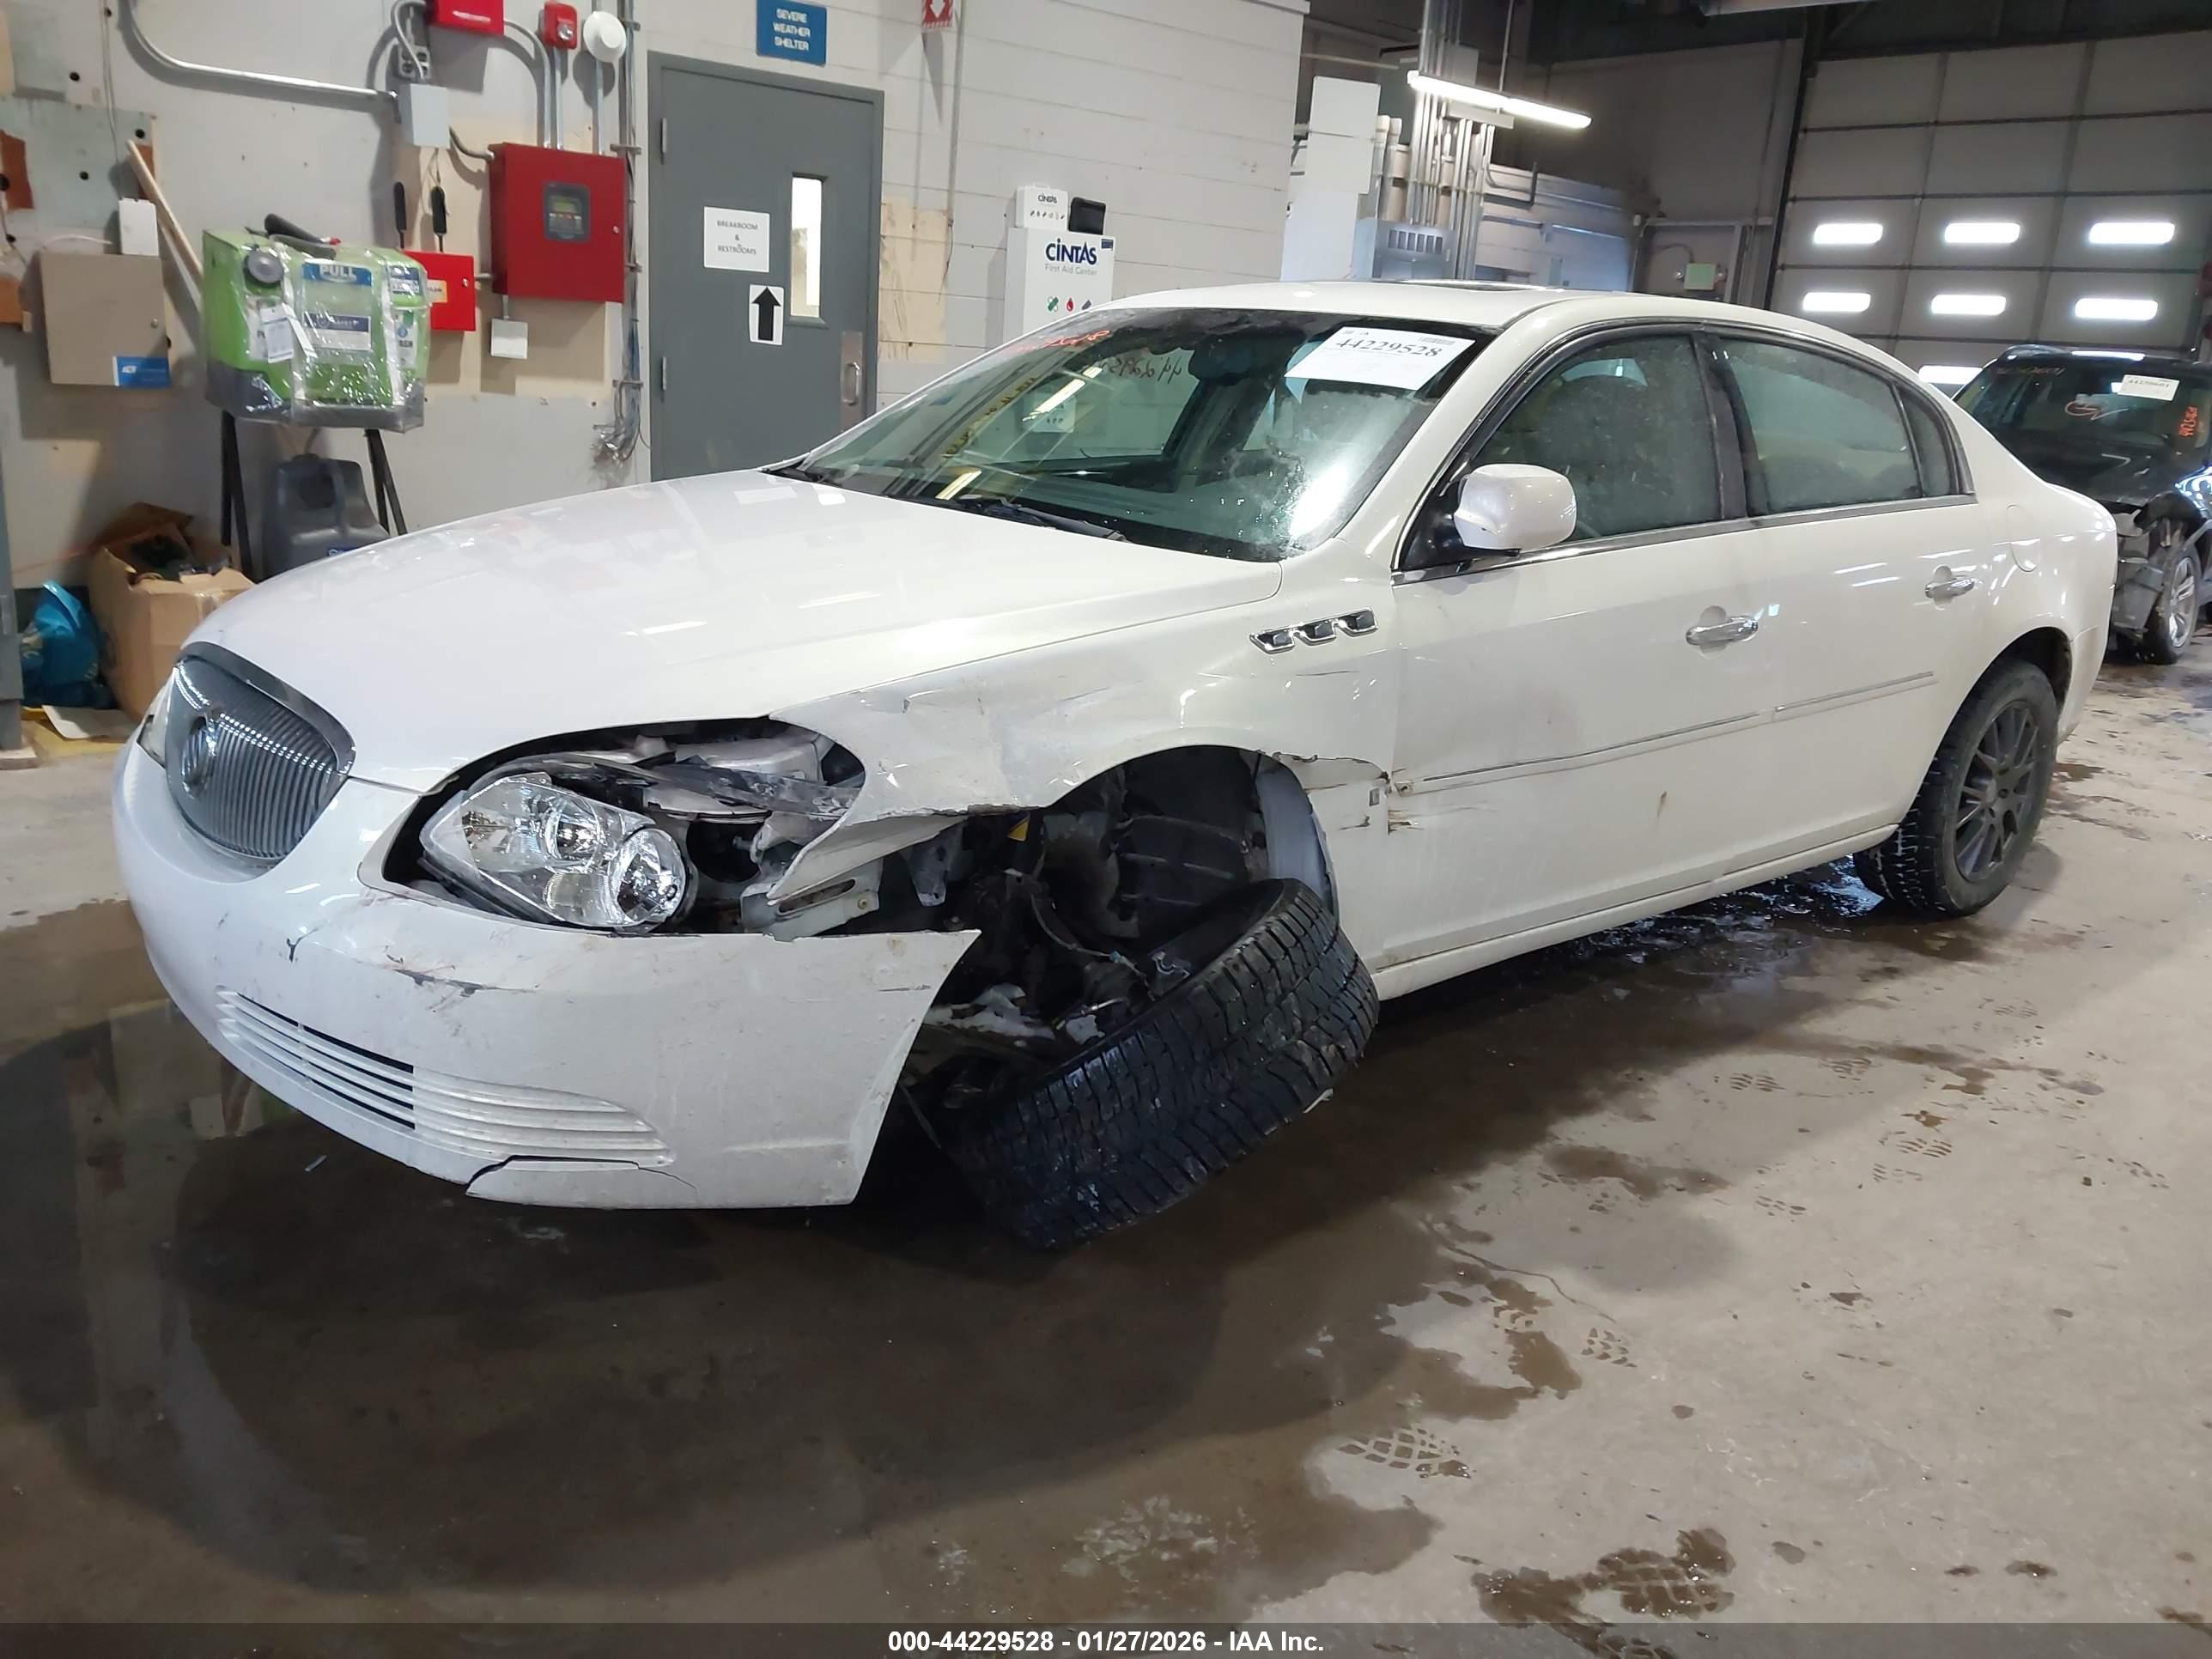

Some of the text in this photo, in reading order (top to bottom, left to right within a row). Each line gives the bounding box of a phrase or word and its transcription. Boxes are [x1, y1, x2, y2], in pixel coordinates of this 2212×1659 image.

[776, 8, 807, 23] SEVERE
[773, 21, 811, 38] WEATHER
[775, 36, 809, 52] SHELTER
[716, 220, 758, 230] BREAKROOM
[717, 245, 757, 255] RESTROOMS
[1045, 238, 1097, 265] CINTAS
[319, 264, 356, 279] PULL
[1045, 263, 1097, 276] First Aid Center
[1335, 337, 1443, 357] 44229528
